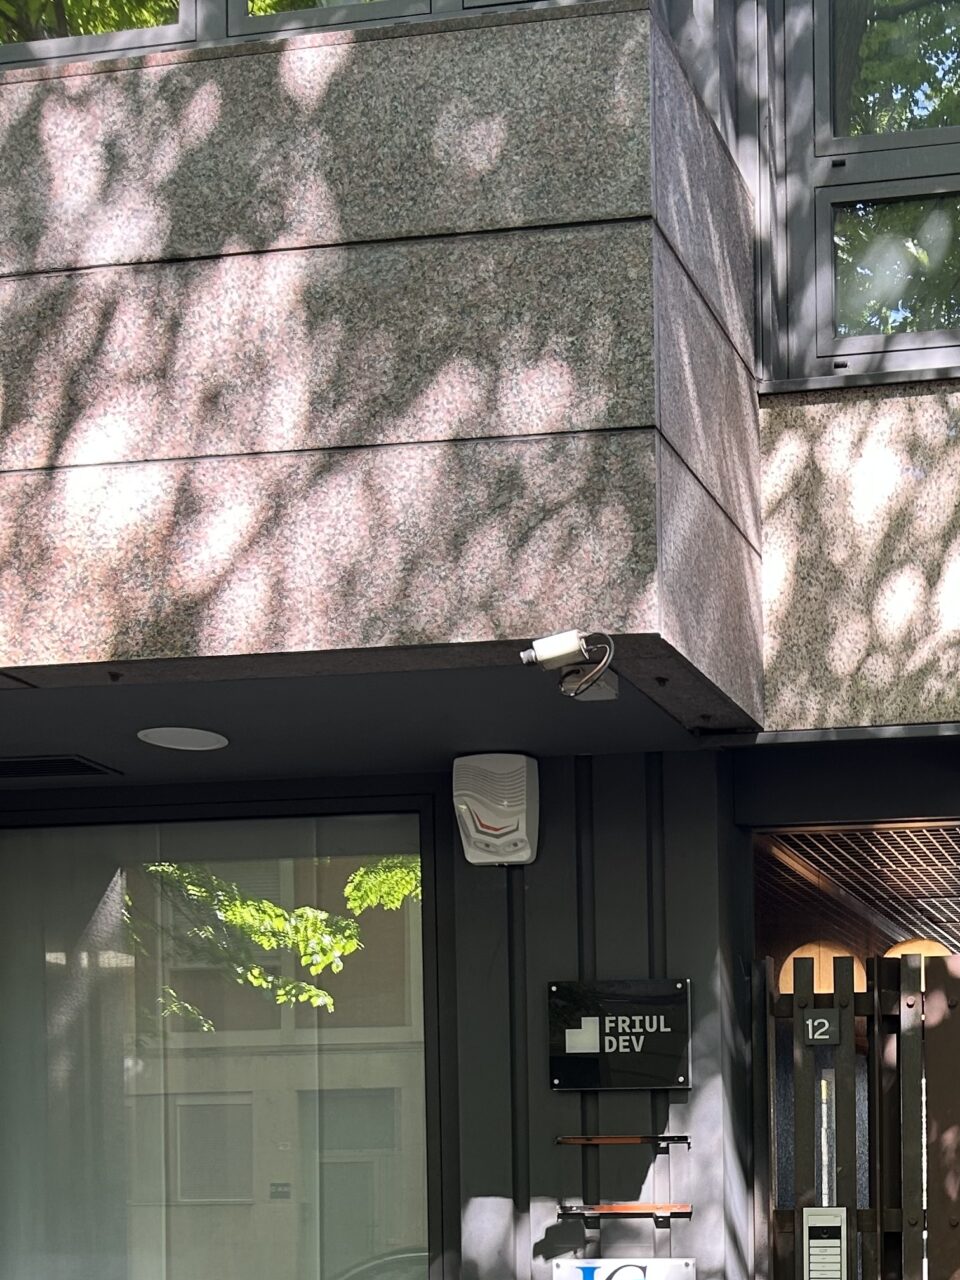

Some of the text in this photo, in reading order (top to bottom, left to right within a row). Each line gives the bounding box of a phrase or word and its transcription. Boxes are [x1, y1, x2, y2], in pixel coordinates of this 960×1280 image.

[604, 1015, 671, 1033] FRIUL
[805, 1018, 830, 1039] 12
[604, 1035, 645, 1053] DEV
